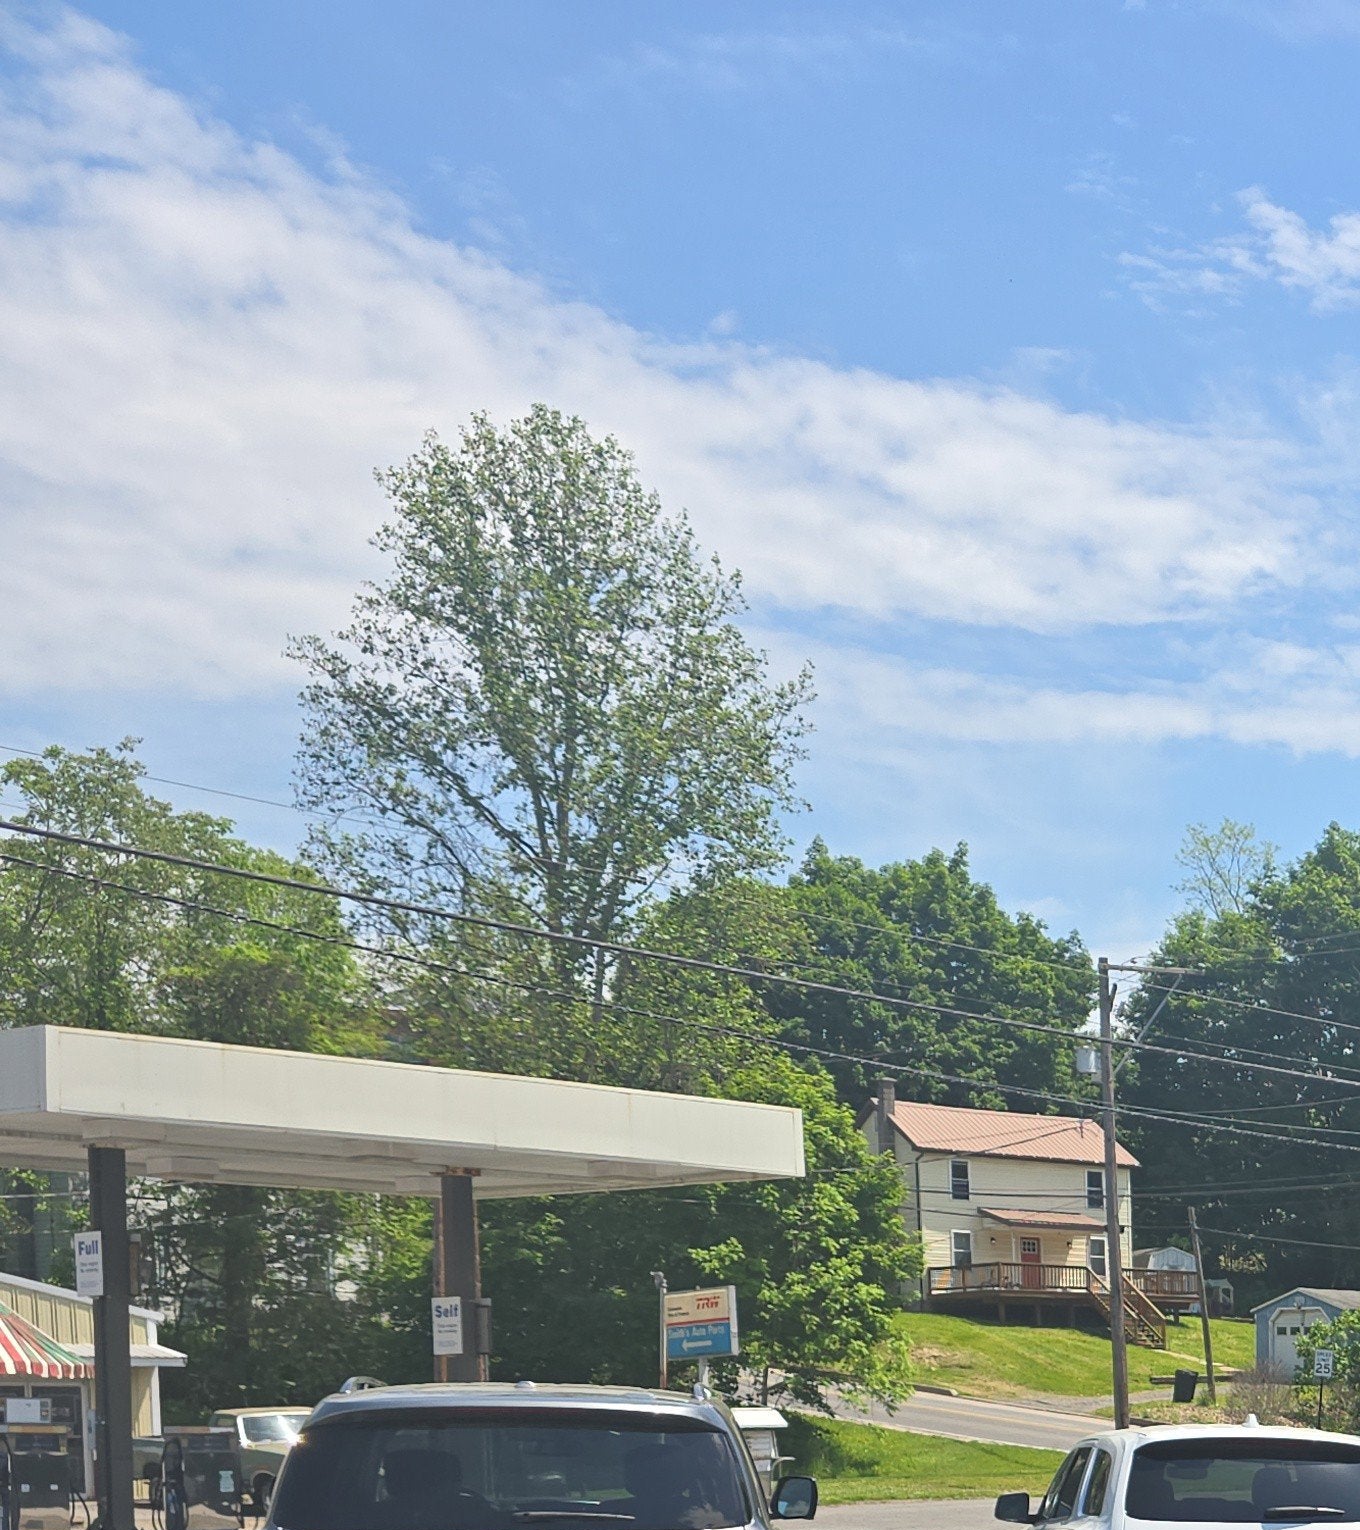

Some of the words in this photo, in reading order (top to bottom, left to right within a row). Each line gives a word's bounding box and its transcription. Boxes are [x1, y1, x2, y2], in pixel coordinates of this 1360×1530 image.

[78, 1240, 99, 1256] Full
[435, 1304, 458, 1318] Self
[1315, 1363, 1331, 1374] 25
